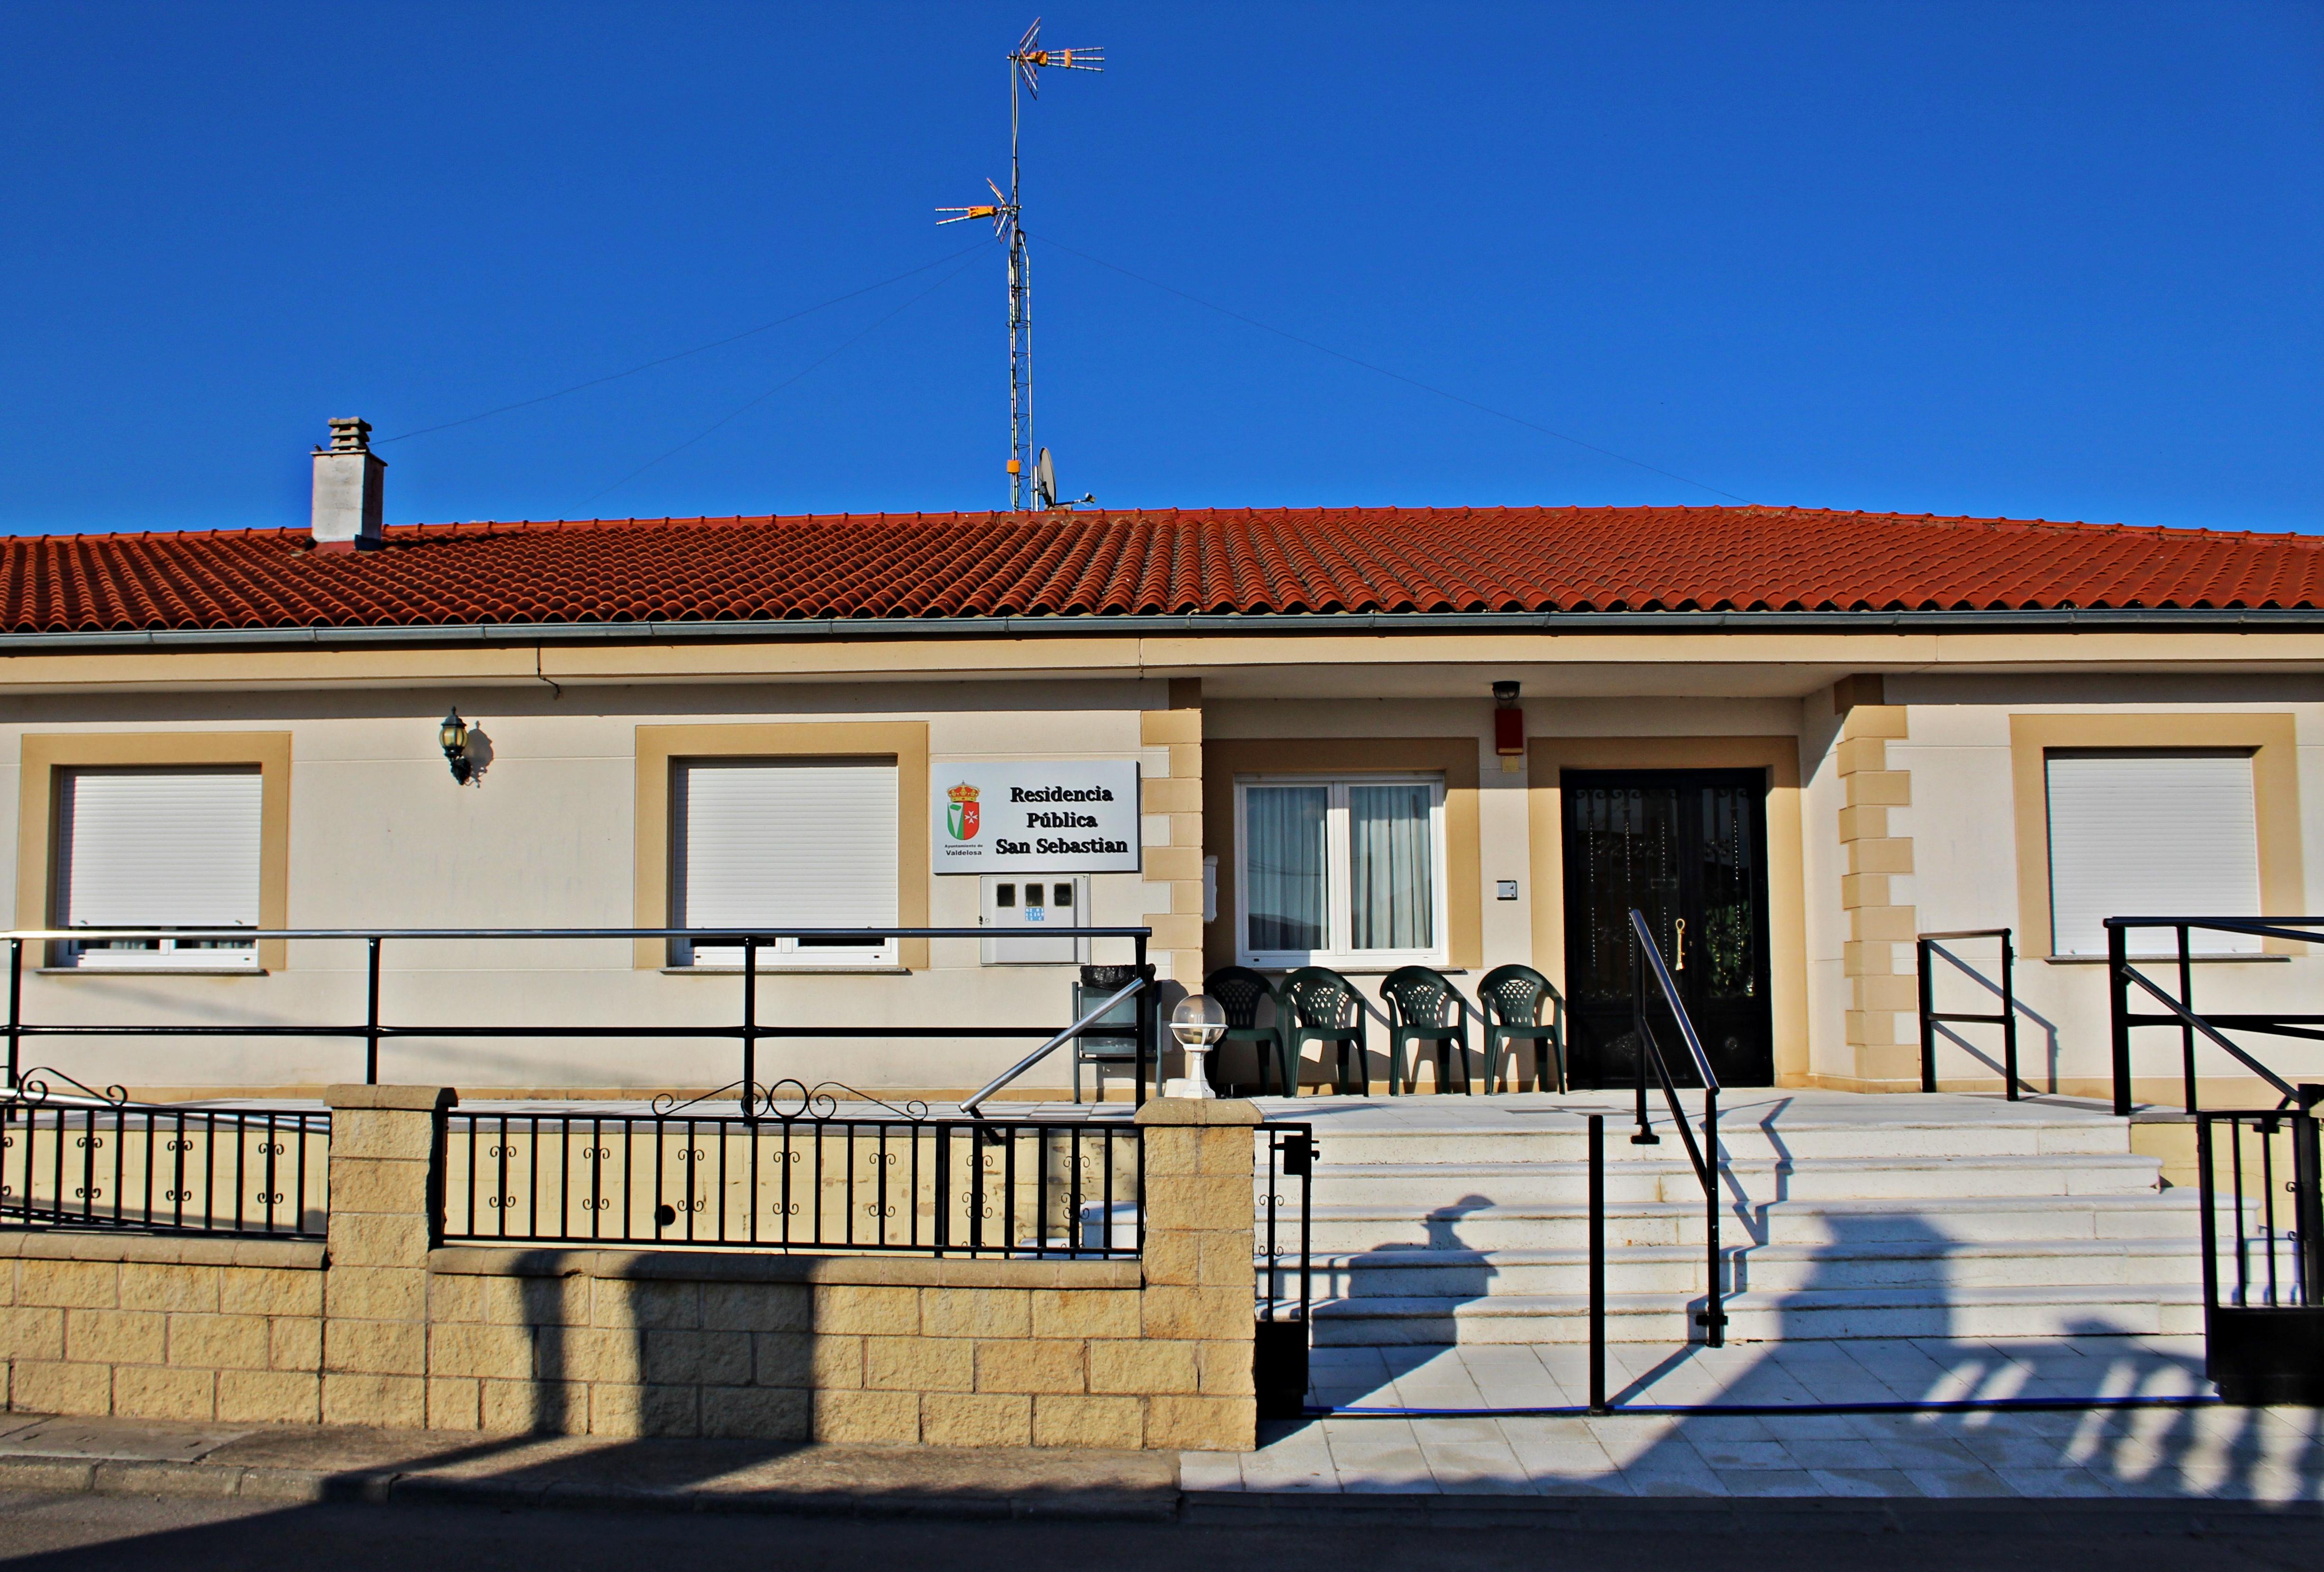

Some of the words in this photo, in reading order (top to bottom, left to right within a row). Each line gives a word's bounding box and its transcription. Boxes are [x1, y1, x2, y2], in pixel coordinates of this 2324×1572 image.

[1010, 785, 1114, 803] Residencia
[1026, 811, 1098, 828] Pública
[996, 838, 1032, 855] San
[1036, 837, 1129, 854] Sebastian
